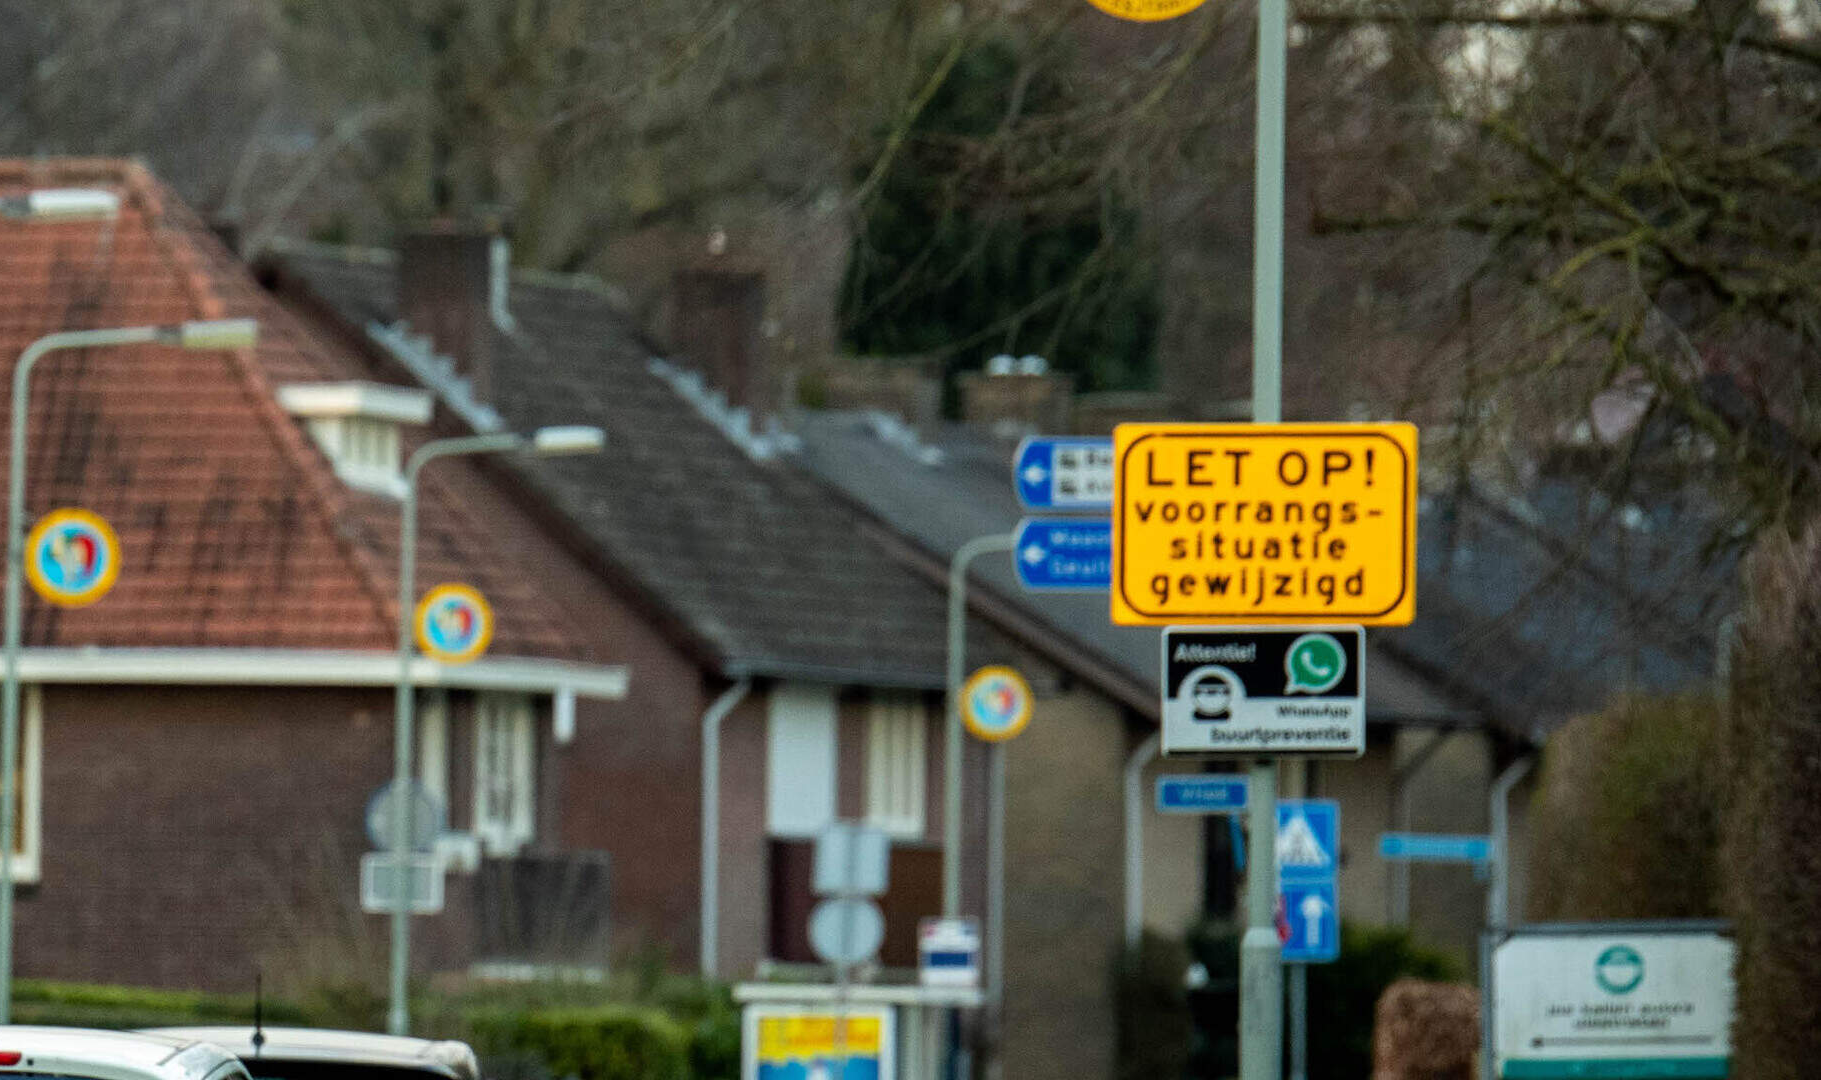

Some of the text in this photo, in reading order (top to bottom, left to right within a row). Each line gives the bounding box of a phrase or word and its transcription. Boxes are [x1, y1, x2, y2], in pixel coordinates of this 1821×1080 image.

[1146, 449, 1376, 487] LET OP!
[1135, 500, 1384, 532] voorrangs-
[1170, 532, 1347, 560] situatie
[1151, 568, 1365, 605] gewijzigd
[1174, 642, 1257, 663] Attentie!
